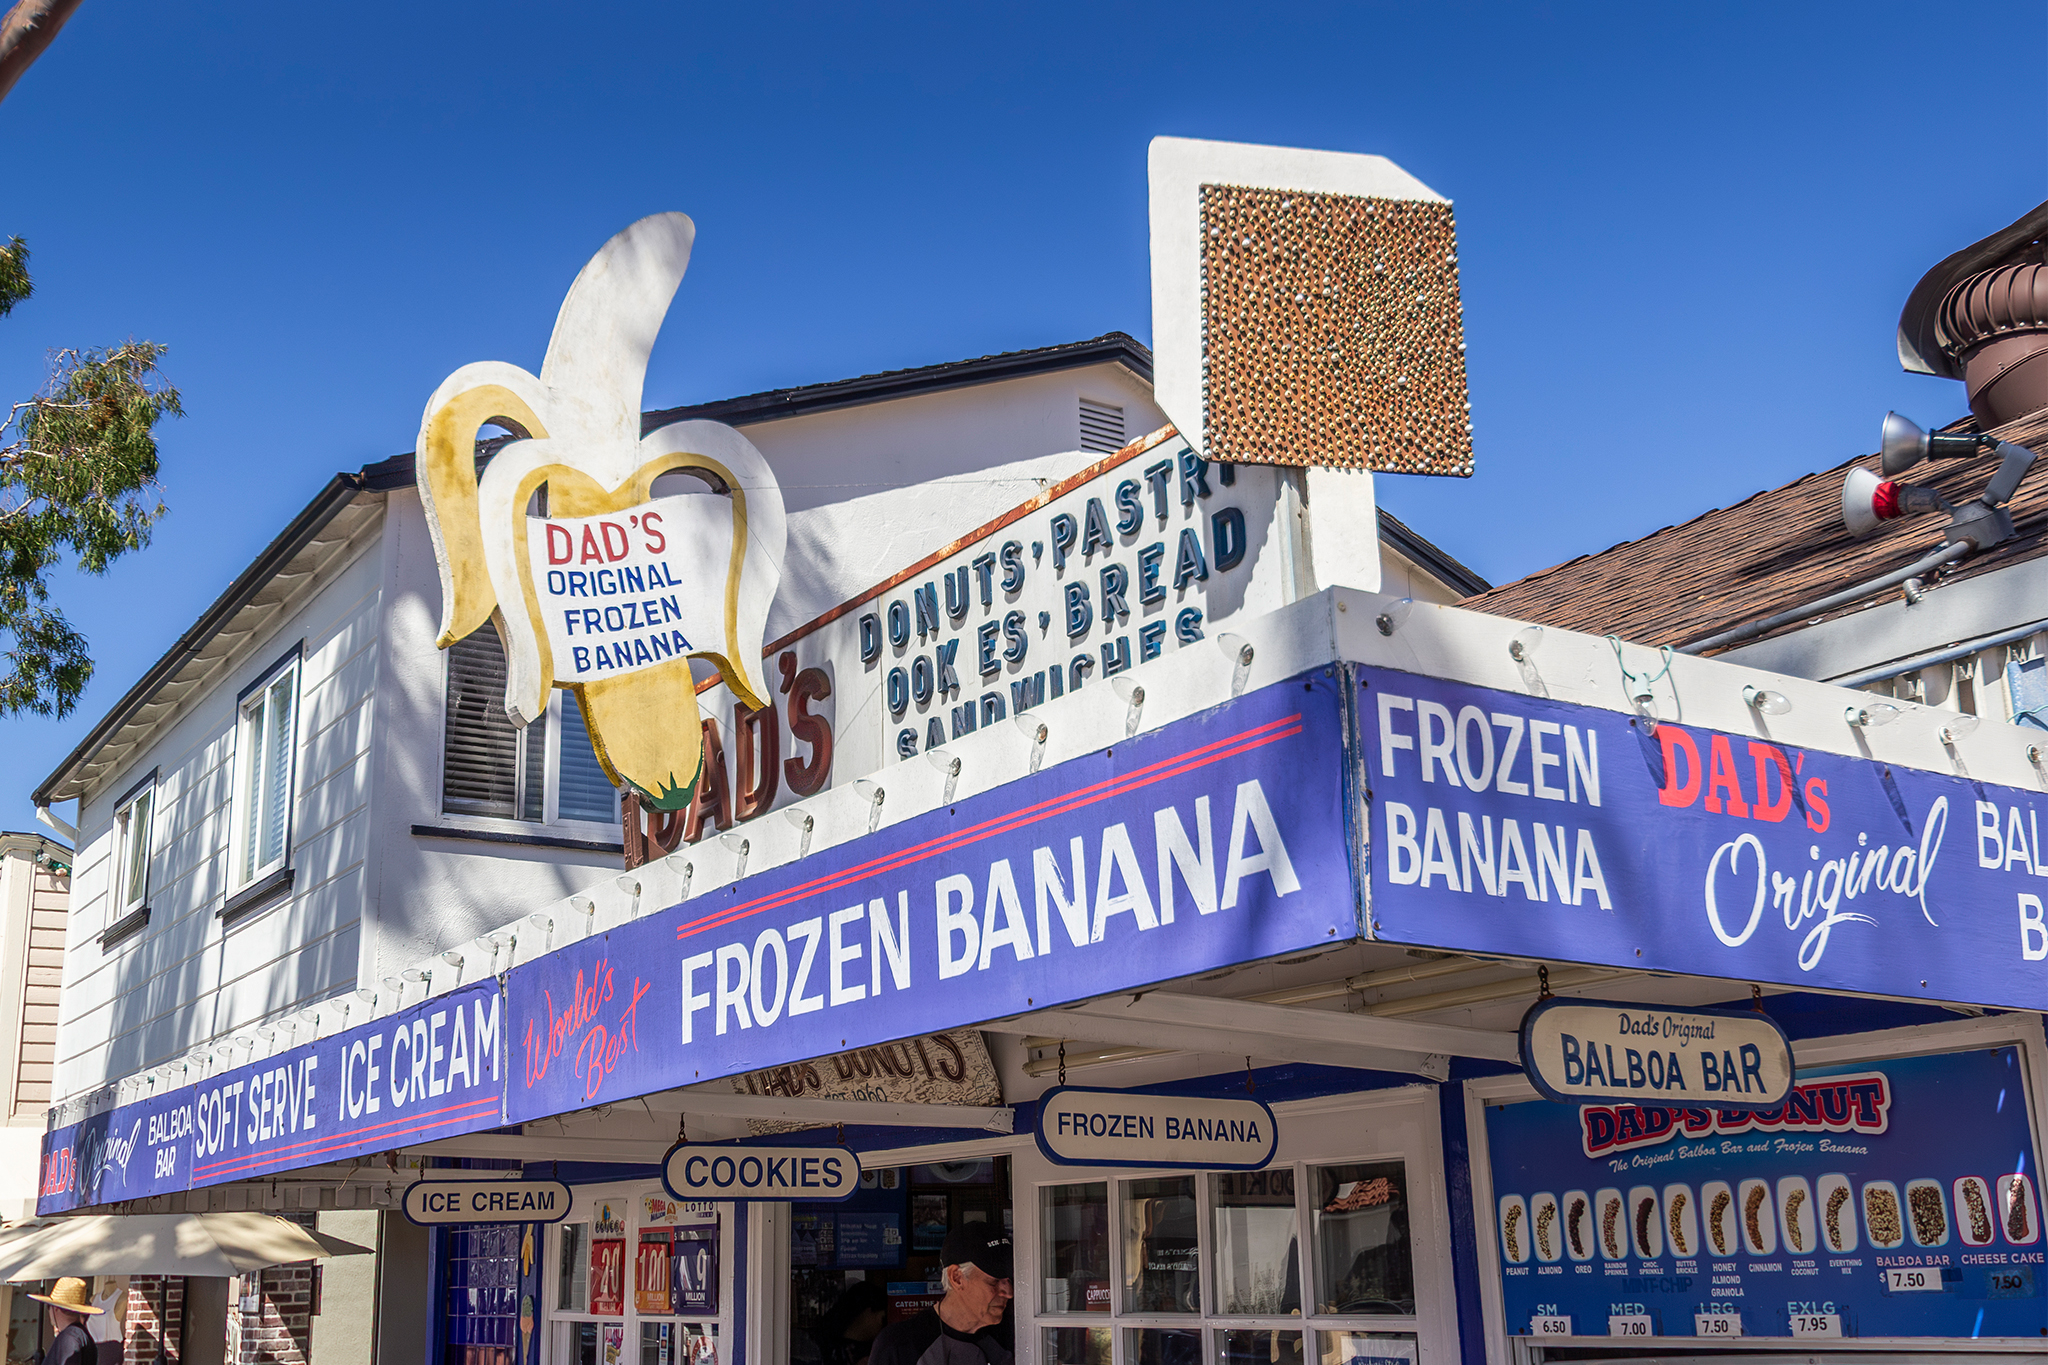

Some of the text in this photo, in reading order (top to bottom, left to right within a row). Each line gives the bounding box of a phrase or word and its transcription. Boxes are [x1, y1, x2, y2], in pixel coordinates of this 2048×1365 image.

[546, 512, 666, 565] DAD'S
[547, 562, 682, 597] ORIGINAL
[1064, 506, 1247, 638] BREAD
[565, 595, 682, 635] FROZEN
[573, 630, 693, 673] BANANA
[1376, 692, 1602, 807] FROZEN
[1657, 724, 1831, 834] DAD's
[1976, 800, 2048, 877] BAL
[1385, 800, 1612, 910] BANANA
[1704, 795, 1949, 971] Original
[681, 779, 1302, 1044] FROZEN BANANA
[522, 958, 614, 1089] World's
[1618, 1012, 1715, 1048] Dad's Original
[575, 977, 651, 1100] Best
[1560, 1033, 1767, 1095] BALBOA BAR
[196, 993, 499, 1159] SOFT SERVE ICE CREAM
[147, 1104, 193, 1146] BALBOA
[1057, 1111, 1262, 1144] FROZEN BANANA
[79, 1117, 141, 1196] Original
[155, 1146, 177, 1179] BAR
[1609, 1159, 1628, 1173] The
[1632, 1152, 1674, 1168] Original
[1678, 1145, 1716, 1159] Balboa
[1721, 1141, 1743, 1154] Bar
[1747, 1140, 1769, 1152] and
[1818, 1139, 1868, 1155] Banana
[685, 1155, 843, 1189] COOKIES
[422, 1190, 555, 1212] ICE CREAM
[685, 1202, 714, 1213] LOTTO
[1829, 1259, 1863, 1267] EVERYTHING
[1876, 1255, 1950, 1267] BALBOA BAR
[1961, 1252, 2045, 1265] CHEESE CAKE
[1506, 1267, 1529, 1276] PEANUT
[1537, 1266, 1562, 1275] ALMOND
[1575, 1265, 1592, 1274] OREO
[1639, 1267, 1664, 1275] SPRINKLE
[1712, 1263, 1737, 1272] HONEY
[1749, 1263, 1782, 1272] CINNAMON
[1791, 1267, 1819, 1276] COCONUT
[1711, 1275, 1741, 1284] ALMOND
[1893, 1273, 1925, 1287] 7.50
[1992, 1275, 2022, 1290] 7.50
[685, 1292, 706, 1301] MILLION
[1711, 1288, 1744, 1297] GRANOLA
[1537, 1304, 1557, 1316] SM
[1611, 1303, 1645, 1316] MED
[1700, 1302, 1734, 1315] LRG
[1787, 1301, 1836, 1315] EXLG
[1543, 1320, 1566, 1334] 6.50
[1621, 1322, 1646, 1335] 7.00
[1702, 1320, 1729, 1334] 7.50
[1798, 1317, 1827, 1331] 7.95
